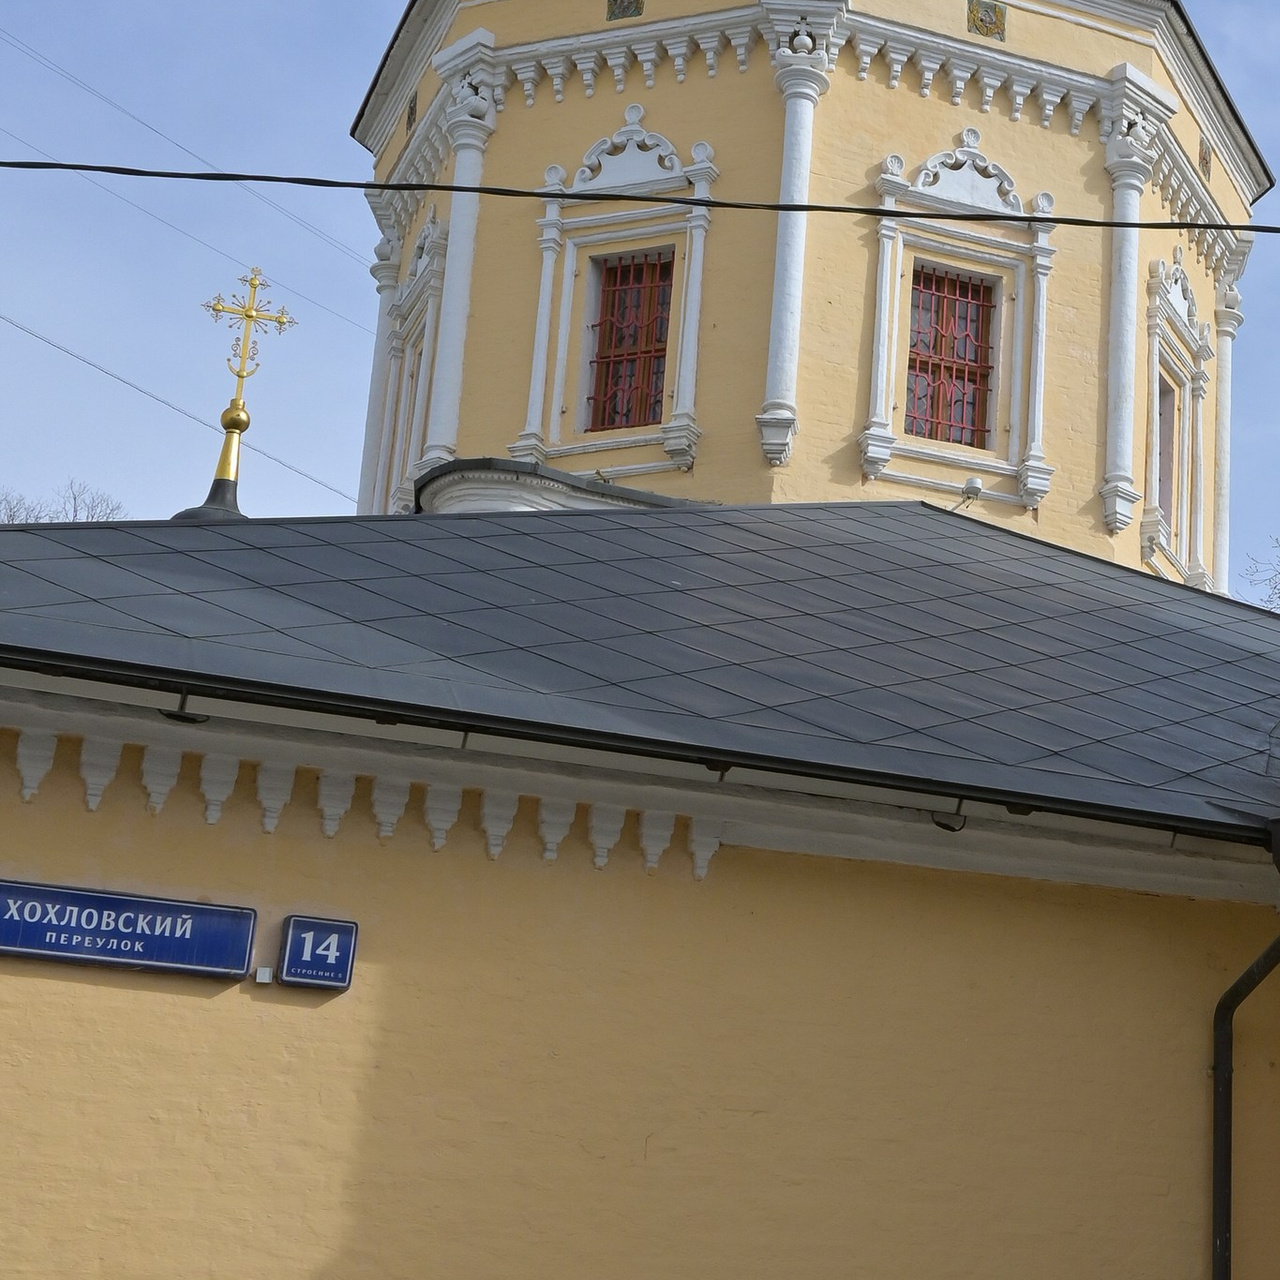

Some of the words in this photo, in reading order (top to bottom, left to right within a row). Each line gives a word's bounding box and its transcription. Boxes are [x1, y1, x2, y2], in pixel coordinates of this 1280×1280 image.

[3, 898, 193, 939] ХОХЛОВСКИЙ
[45, 932, 145, 953] ПЕРЕУЛОК
[301, 931, 340, 964] 14
[291, 967, 336, 978] СТРОЕНИЕ
